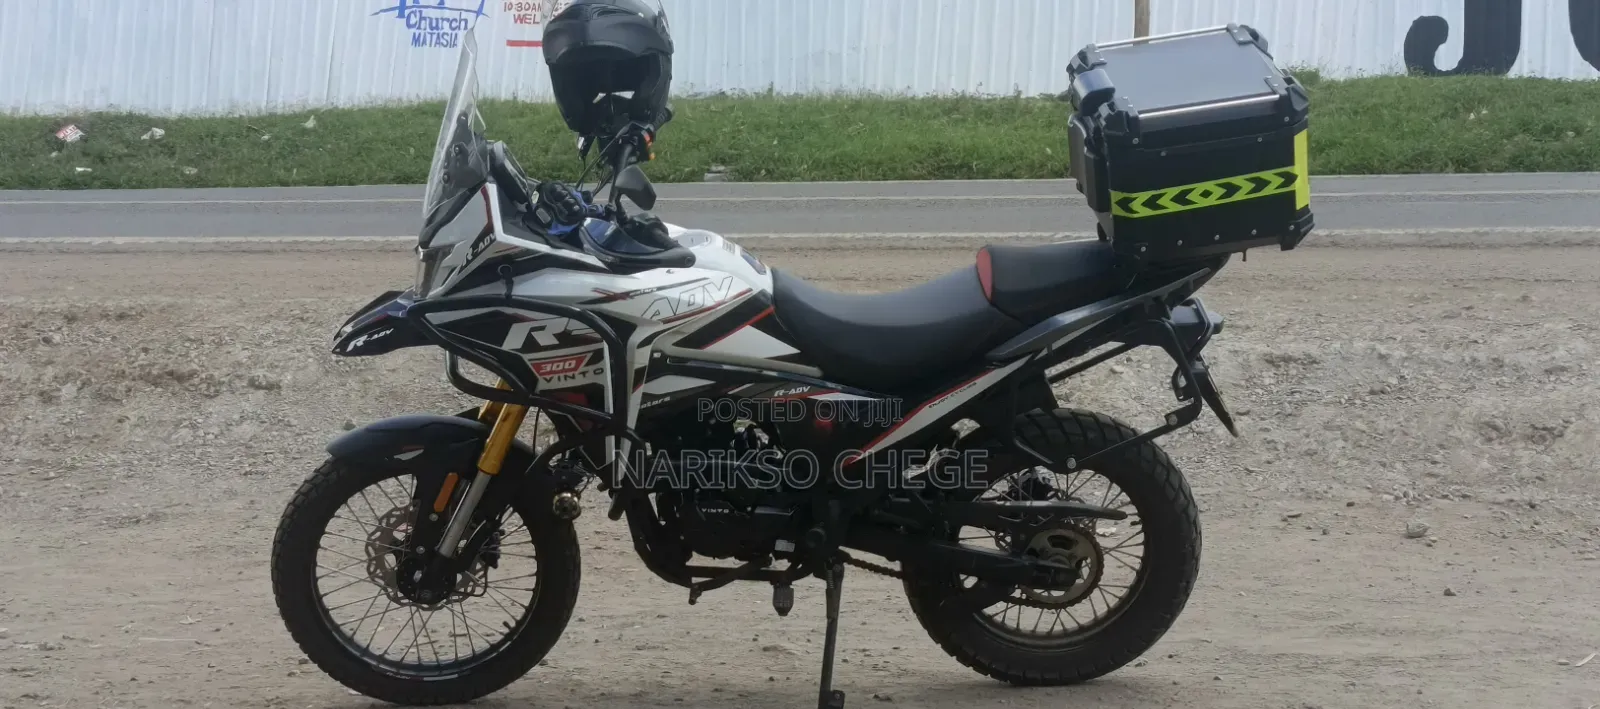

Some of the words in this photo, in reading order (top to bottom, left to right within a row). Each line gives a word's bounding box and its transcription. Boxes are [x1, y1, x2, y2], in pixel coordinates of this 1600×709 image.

[405, 9, 469, 31] Church
[410, 31, 458, 48] MATASIA
[345, 327, 395, 353] R-ADV
[540, 360, 577, 373] 300
[541, 367, 605, 384] VINTO
[773, 385, 811, 397] R-ADV
